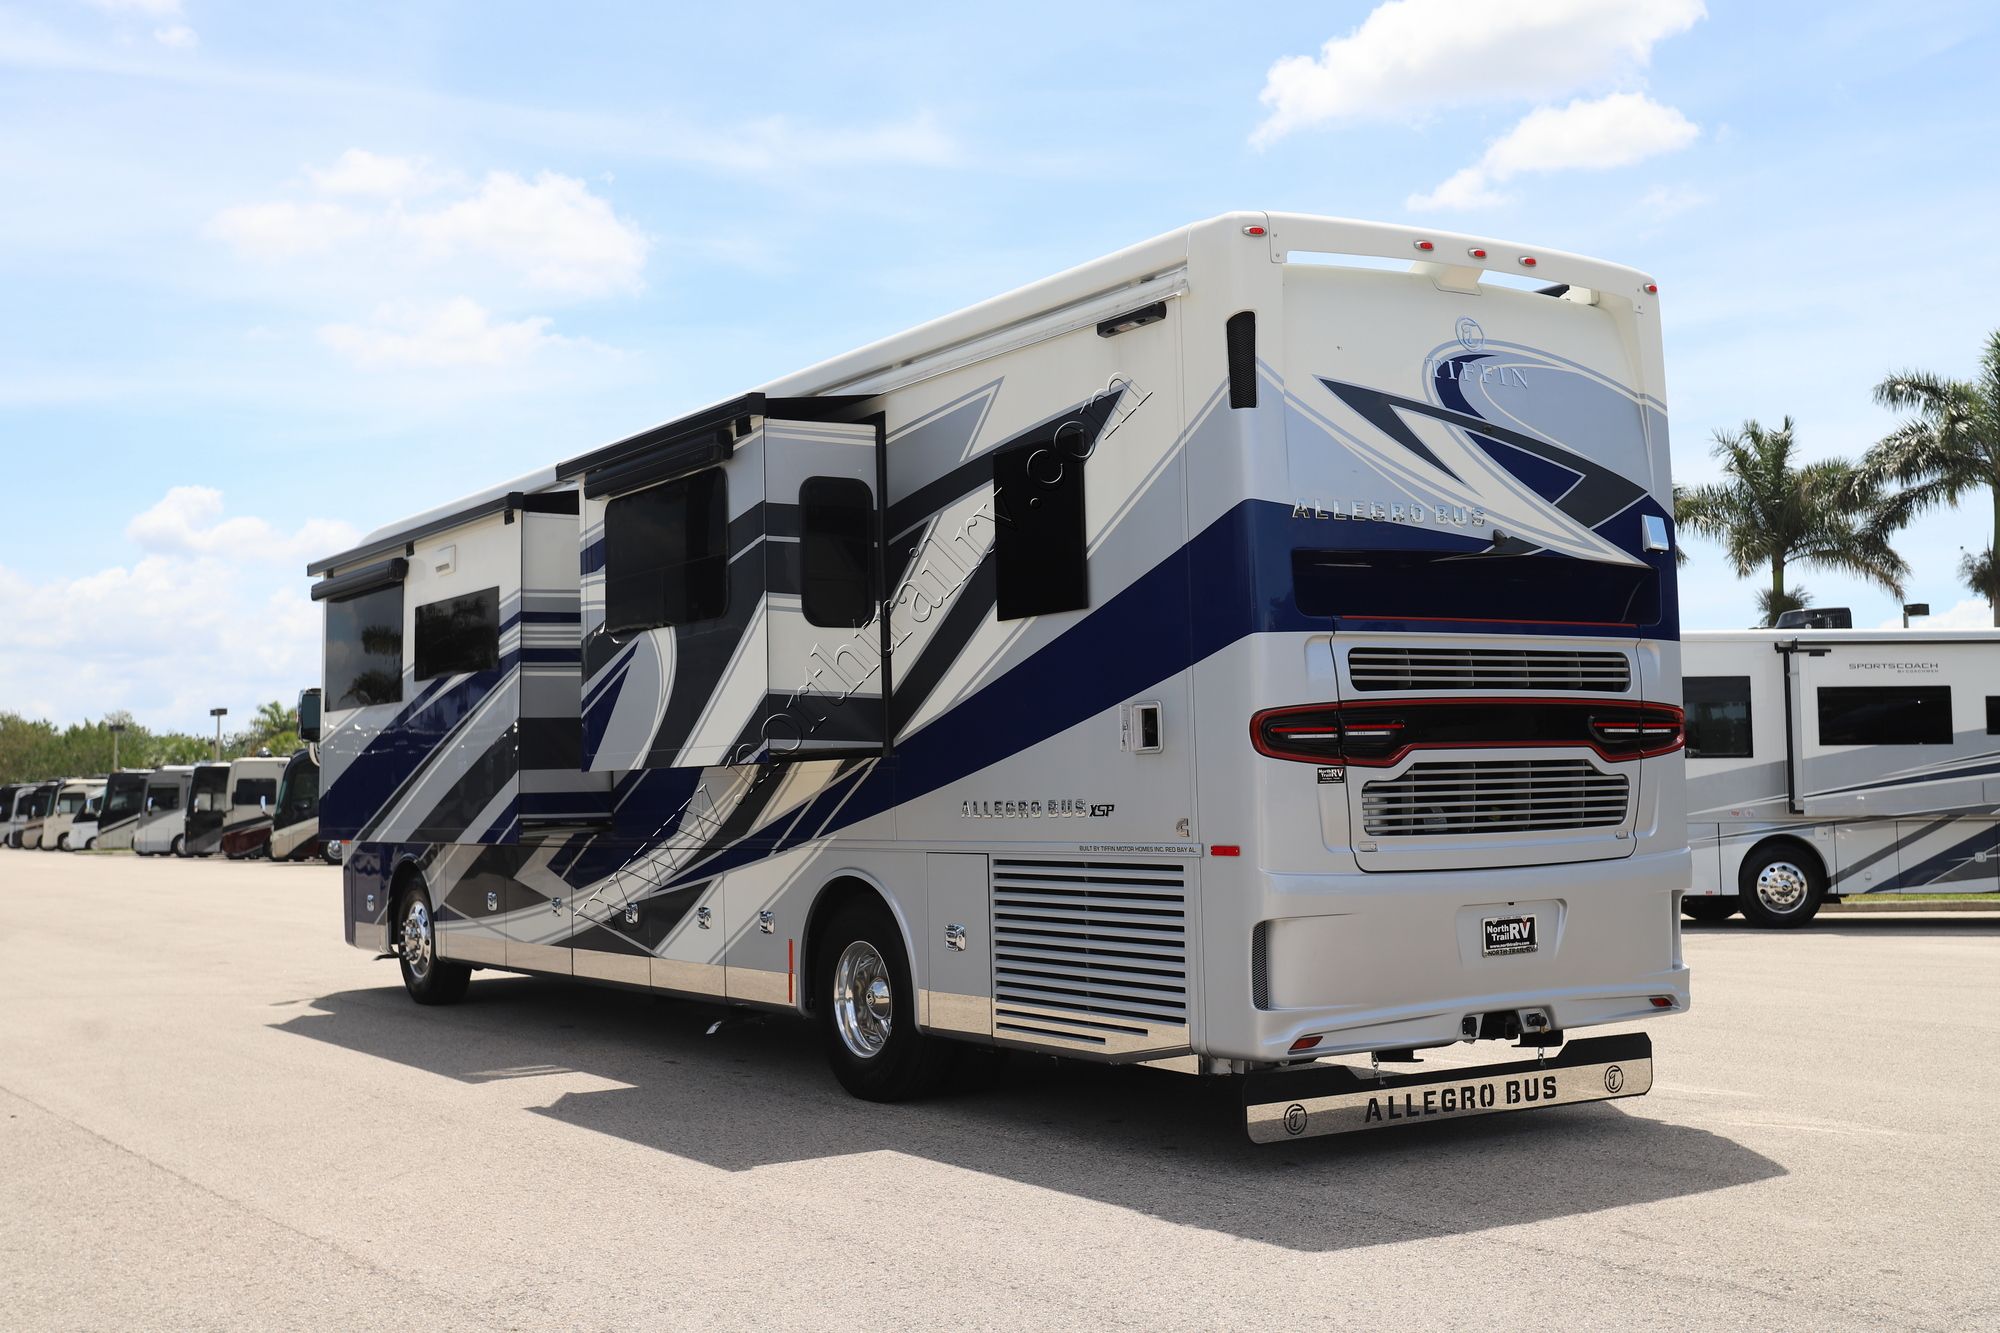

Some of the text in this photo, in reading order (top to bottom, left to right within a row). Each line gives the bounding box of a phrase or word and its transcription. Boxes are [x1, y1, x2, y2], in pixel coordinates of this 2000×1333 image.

[1424, 357, 1528, 389] TIFFIN
[1292, 498, 1486, 528] ALLEGRO BUS
[1331, 768, 1344, 778] RV
[961, 799, 1115, 818] ALLEGRO BUS XSP
[1486, 921, 1531, 940] North RV
[1491, 932, 1510, 942] Trail
[1364, 1075, 1557, 1123] ALLEGRO BUS
